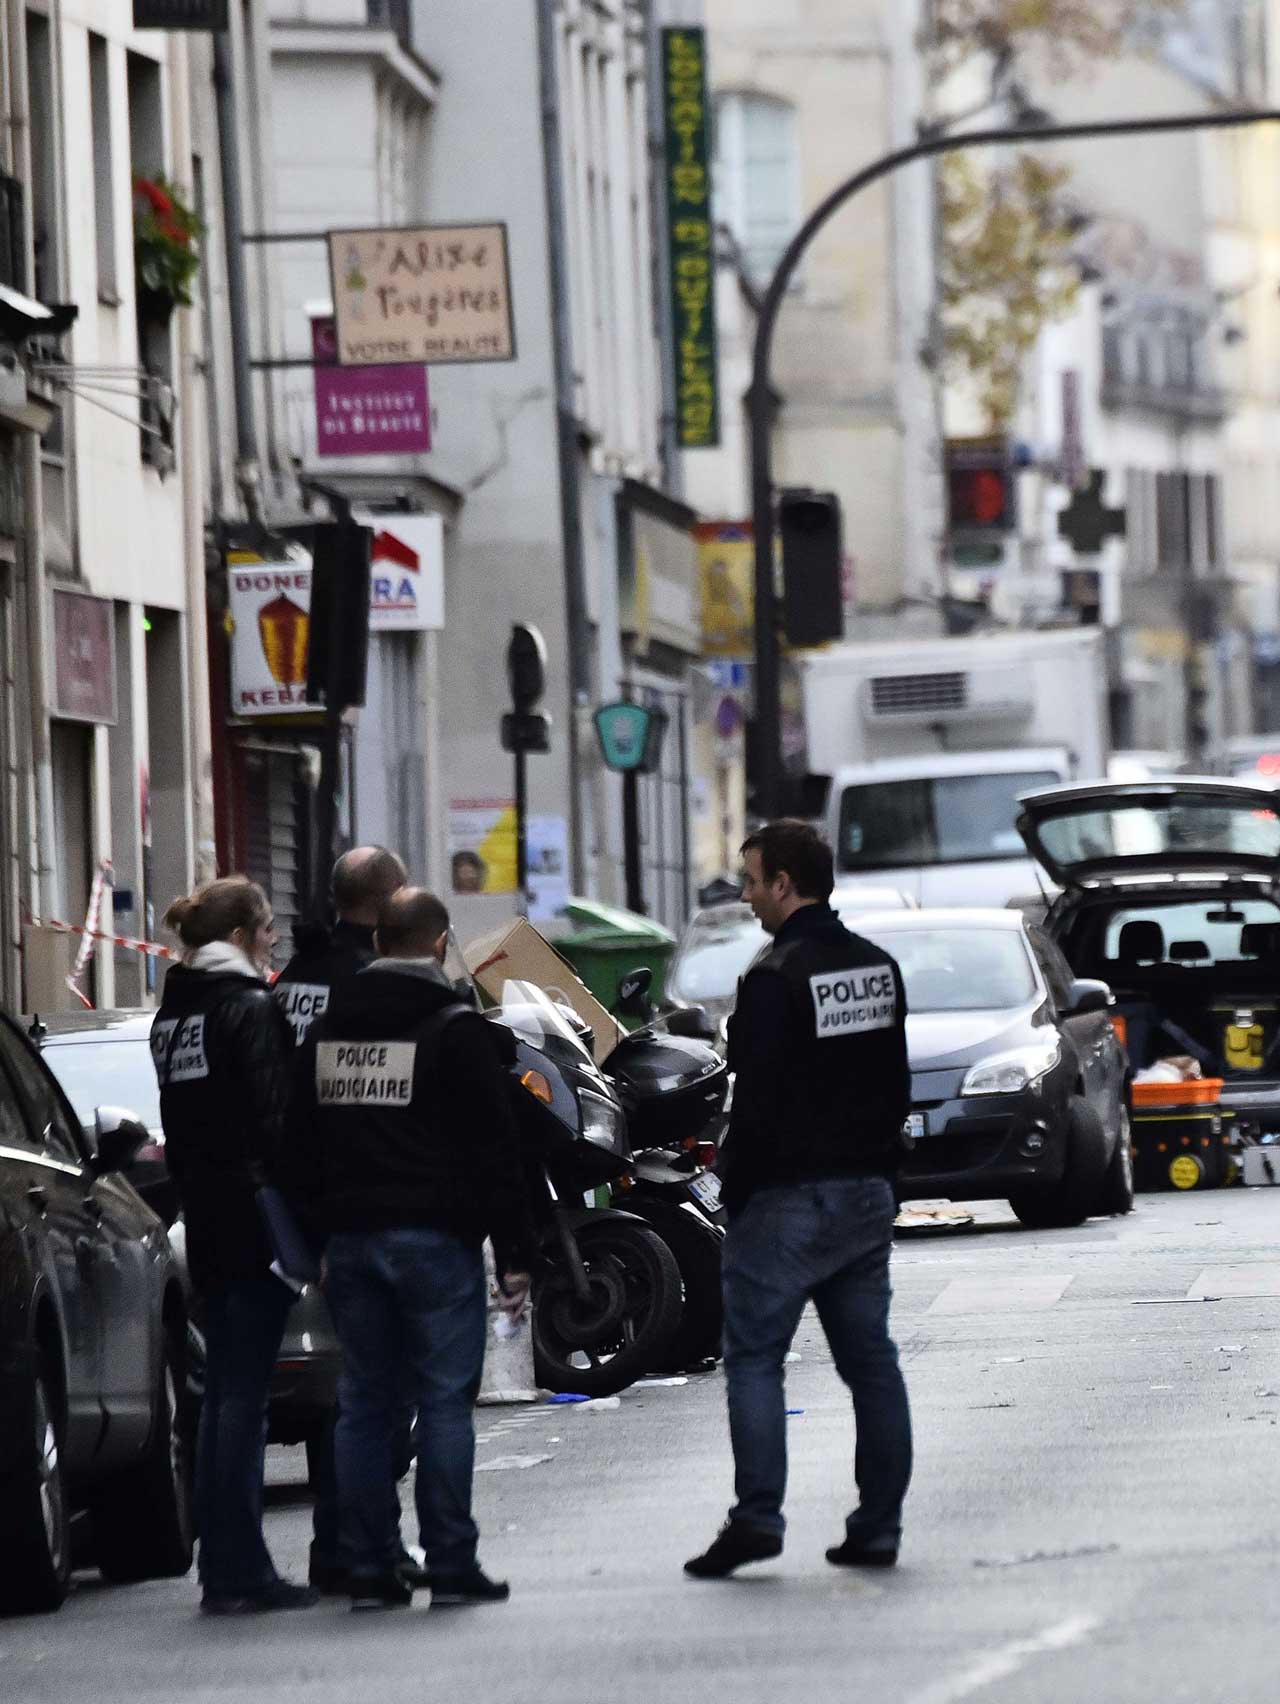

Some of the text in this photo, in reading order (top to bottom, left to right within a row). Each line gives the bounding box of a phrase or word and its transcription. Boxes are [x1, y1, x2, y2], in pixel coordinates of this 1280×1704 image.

[236, 574, 308, 592] DONE
[373, 577, 417, 602] RA
[816, 974, 893, 1007] POLICE
[336, 1045, 388, 1068] POLICE
